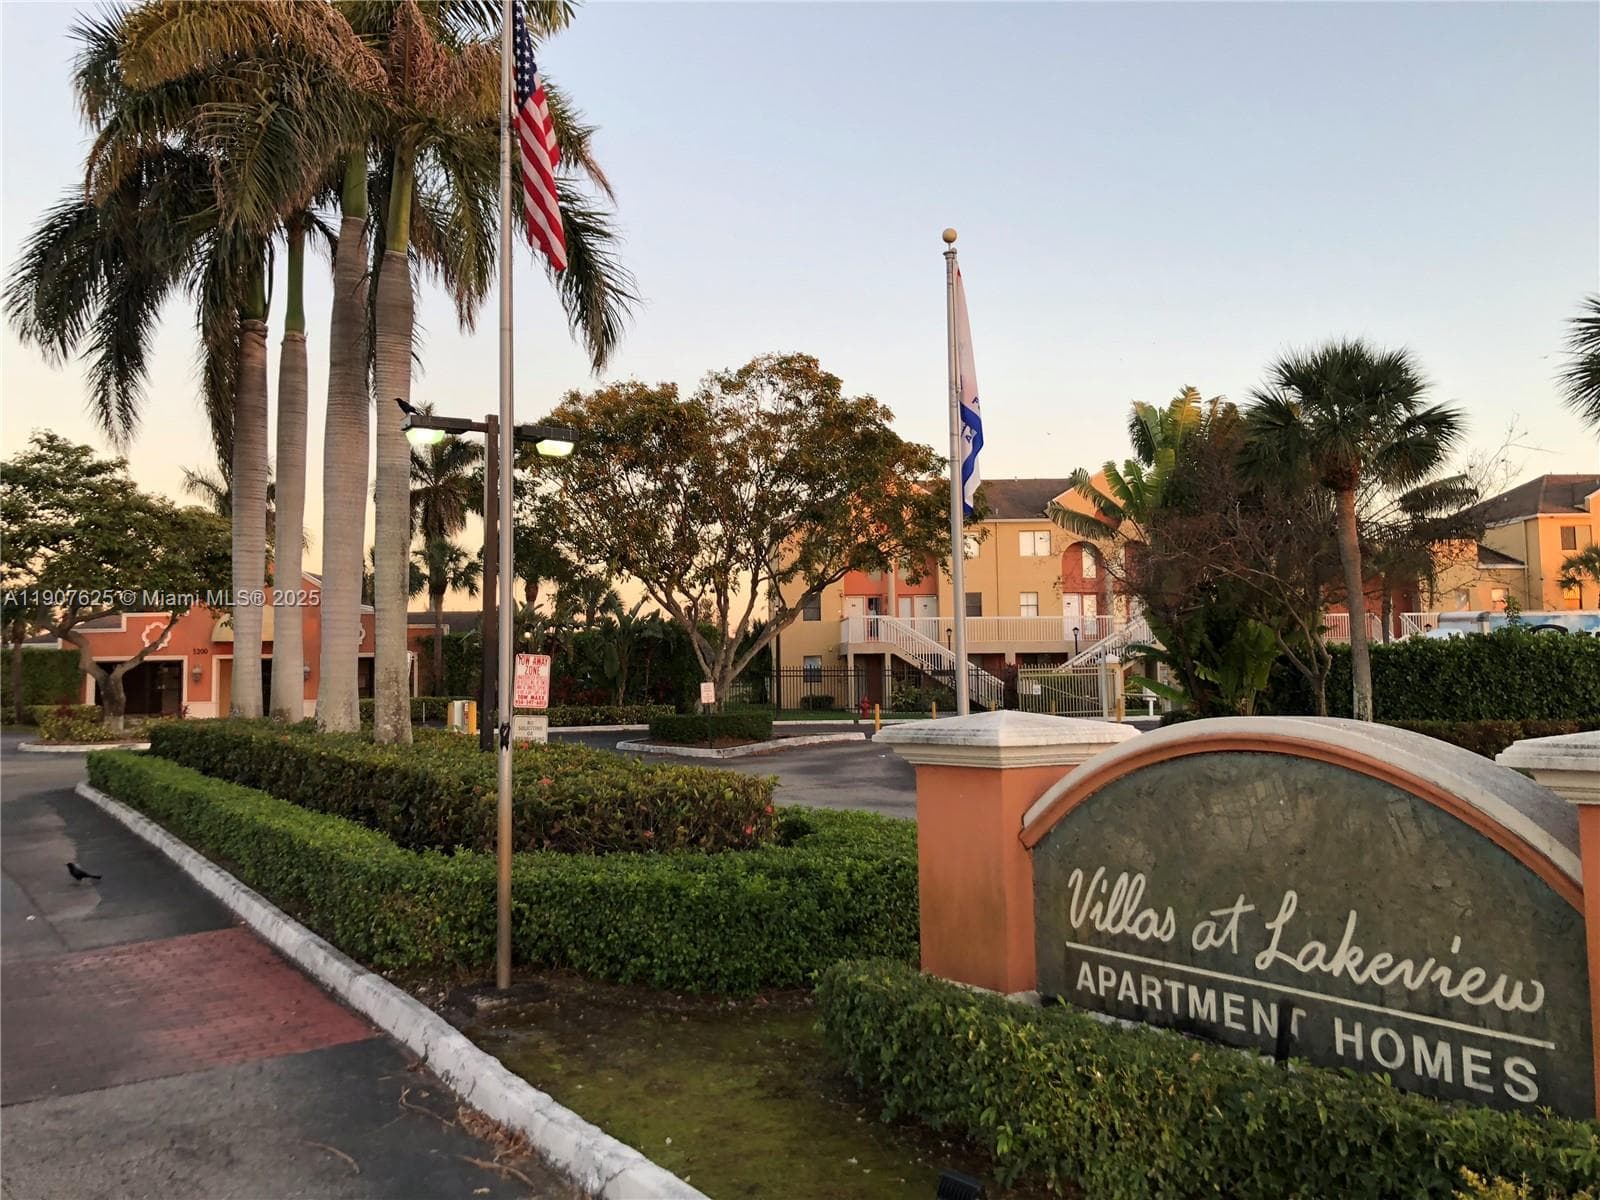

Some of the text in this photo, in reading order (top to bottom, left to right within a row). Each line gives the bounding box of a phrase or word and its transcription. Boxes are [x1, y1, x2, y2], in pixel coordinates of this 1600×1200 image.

[518, 655, 548, 666] TOW AWAY
[525, 666, 541, 676] ZONE
[1068, 866, 1545, 1012] Villas at Lakeview
[1334, 1017, 1539, 1103] HOMES
